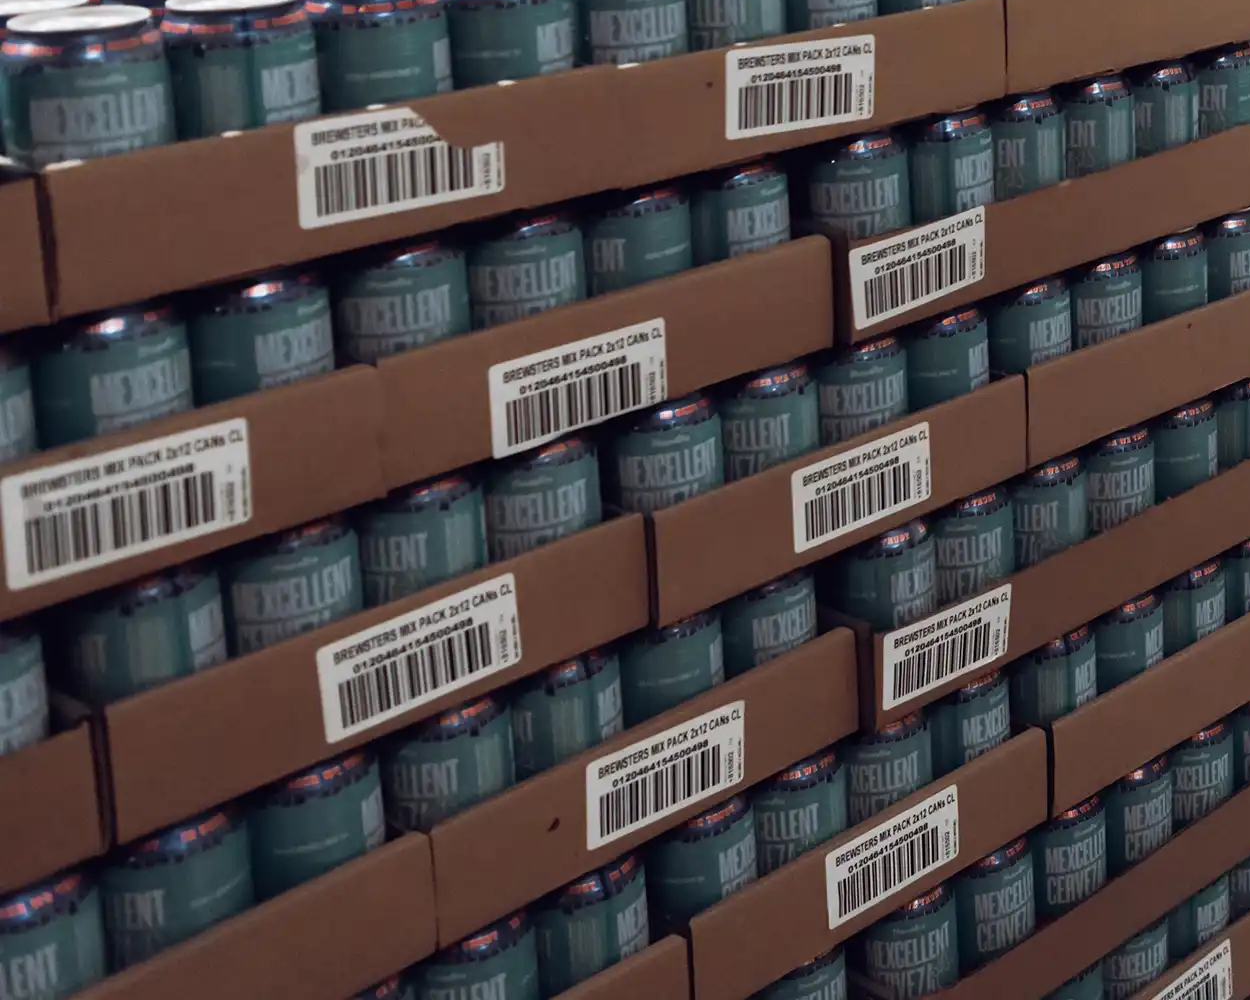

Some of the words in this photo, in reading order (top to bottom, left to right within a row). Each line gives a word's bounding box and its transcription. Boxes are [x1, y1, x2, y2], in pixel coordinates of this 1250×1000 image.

[861, 242, 906, 265] BREWSTERS
[908, 237, 919, 248] MIX
[921, 230, 939, 244] PACK
[956, 218, 973, 231] CANs
[975, 214, 982, 224] CL
[803, 461, 848, 486] BREWSTERS
[849, 456, 861, 468] MIX
[863, 448, 882, 462] PACK
[899, 435, 917, 448] CANs
[919, 431, 927, 440] CL
[894, 623, 935, 649] BREWSTERS
[937, 618, 948, 630] MIX
[949, 610, 967, 627] PACK
[968, 603, 982, 617] 2x12
[983, 597, 999, 610] CANs
[1001, 592, 1008, 602] CL
[905, 617, 982, 657] 0120464154500498
[598, 748, 649, 779] BREWSTERS
[651, 741, 665, 756] MIX
[667, 731, 689, 748] PACK
[690, 723, 708, 739] 2x12
[709, 715, 729, 731] CANs
[731, 708, 741, 721] CL
[612, 739, 709, 788] 0120464154500498
[1175, 753, 1228, 792] XCELLENT
[835, 835, 878, 867] BREWSTERS
[879, 829, 891, 842] MIX
[893, 818, 911, 835] PACK
[912, 809, 927, 824] 2x12
[928, 800, 945, 814] CANs
[947, 794, 955, 804] CL
[848, 823, 928, 873] 0120464154500498
